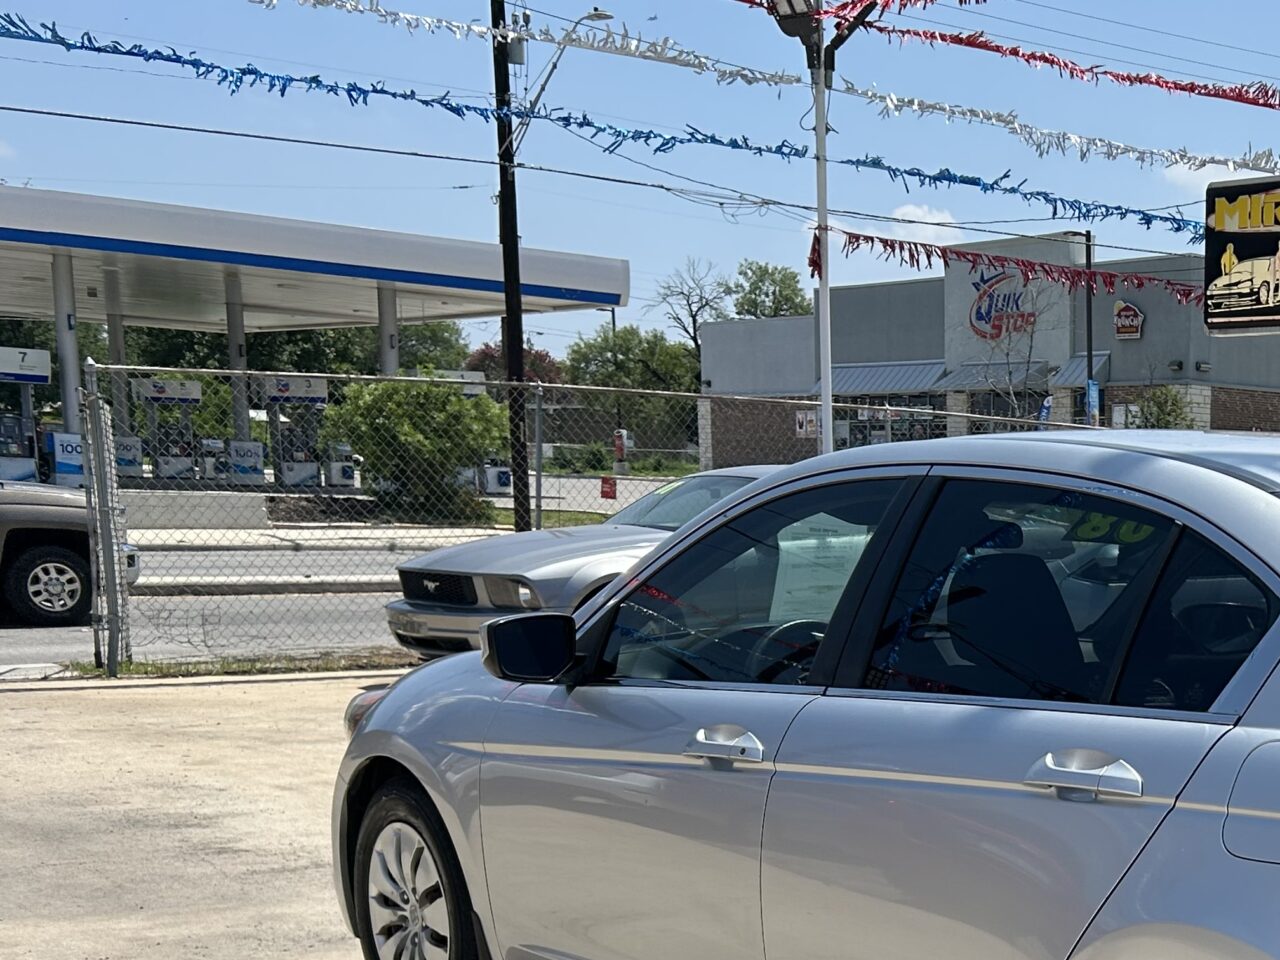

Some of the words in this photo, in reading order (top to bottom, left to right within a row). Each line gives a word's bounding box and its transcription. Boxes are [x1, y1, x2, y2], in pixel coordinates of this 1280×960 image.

[975, 290, 1024, 325] QUIK
[991, 312, 1037, 339] STOP
[18, 351, 28, 363] 7
